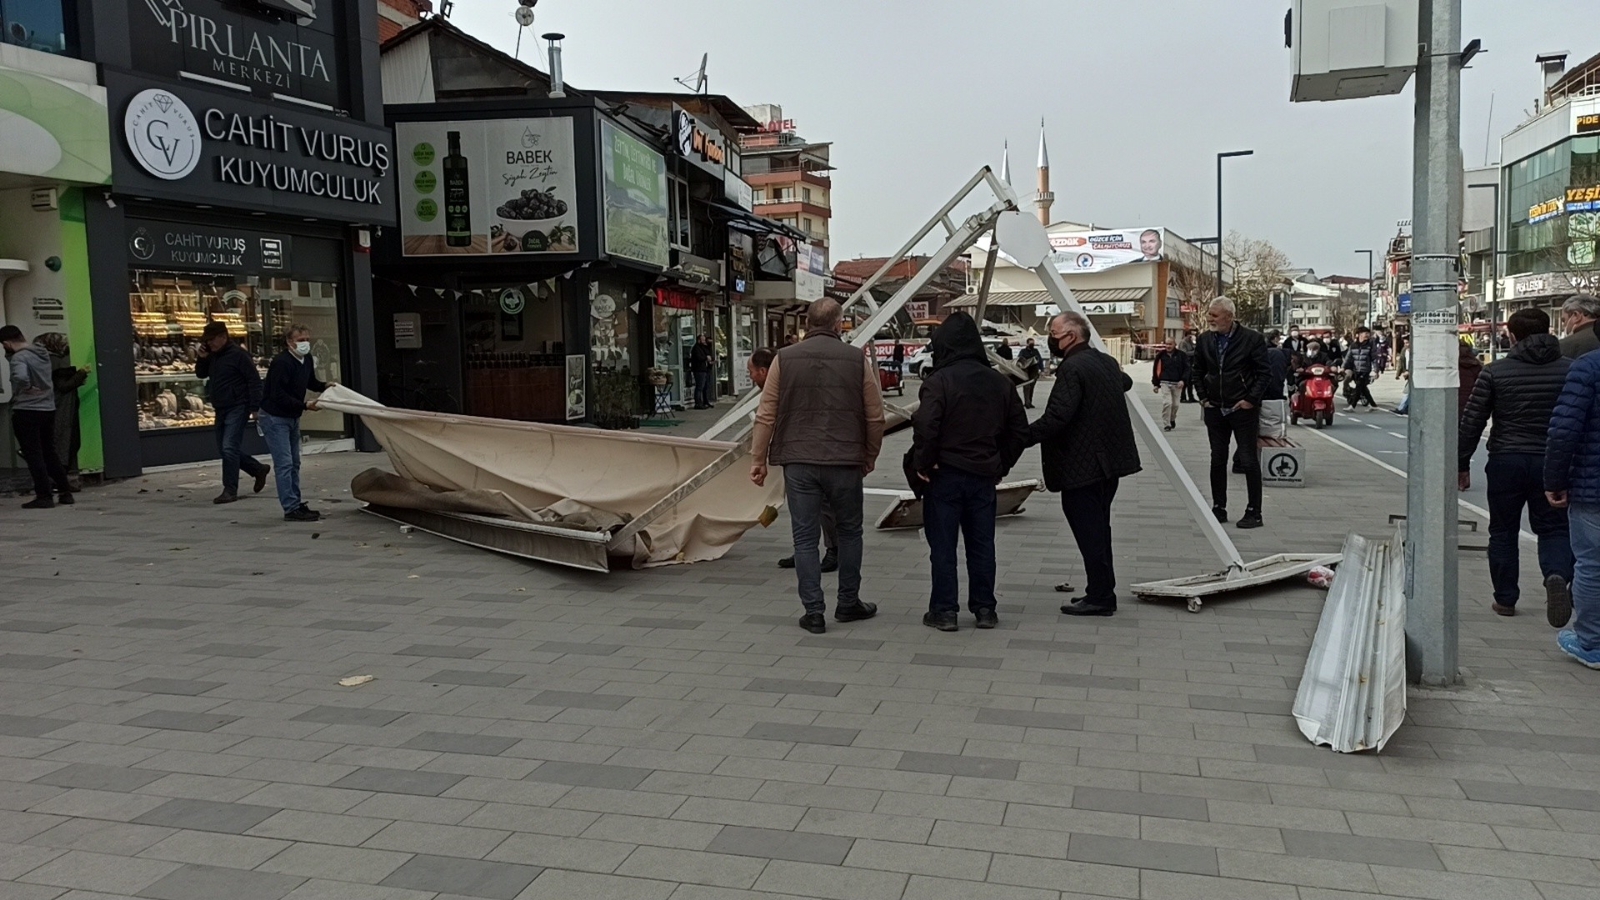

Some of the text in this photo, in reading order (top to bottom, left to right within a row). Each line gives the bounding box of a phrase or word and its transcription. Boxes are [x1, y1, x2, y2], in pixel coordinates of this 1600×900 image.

[170, 8, 330, 82] PIRLANTA
[212, 58, 291, 88] MERKEZİ
[1577, 116, 1599, 125] PİDE
[204, 108, 389, 177] CAHİT VURUŞ
[506, 150, 553, 165] BABEK
[220, 155, 382, 204] KUYUMCULUK
[1566, 185, 1600, 202] YEŞİ
[165, 232, 246, 254] CAHİT VURUŞ
[171, 250, 243, 266] KUYUMCULUK
